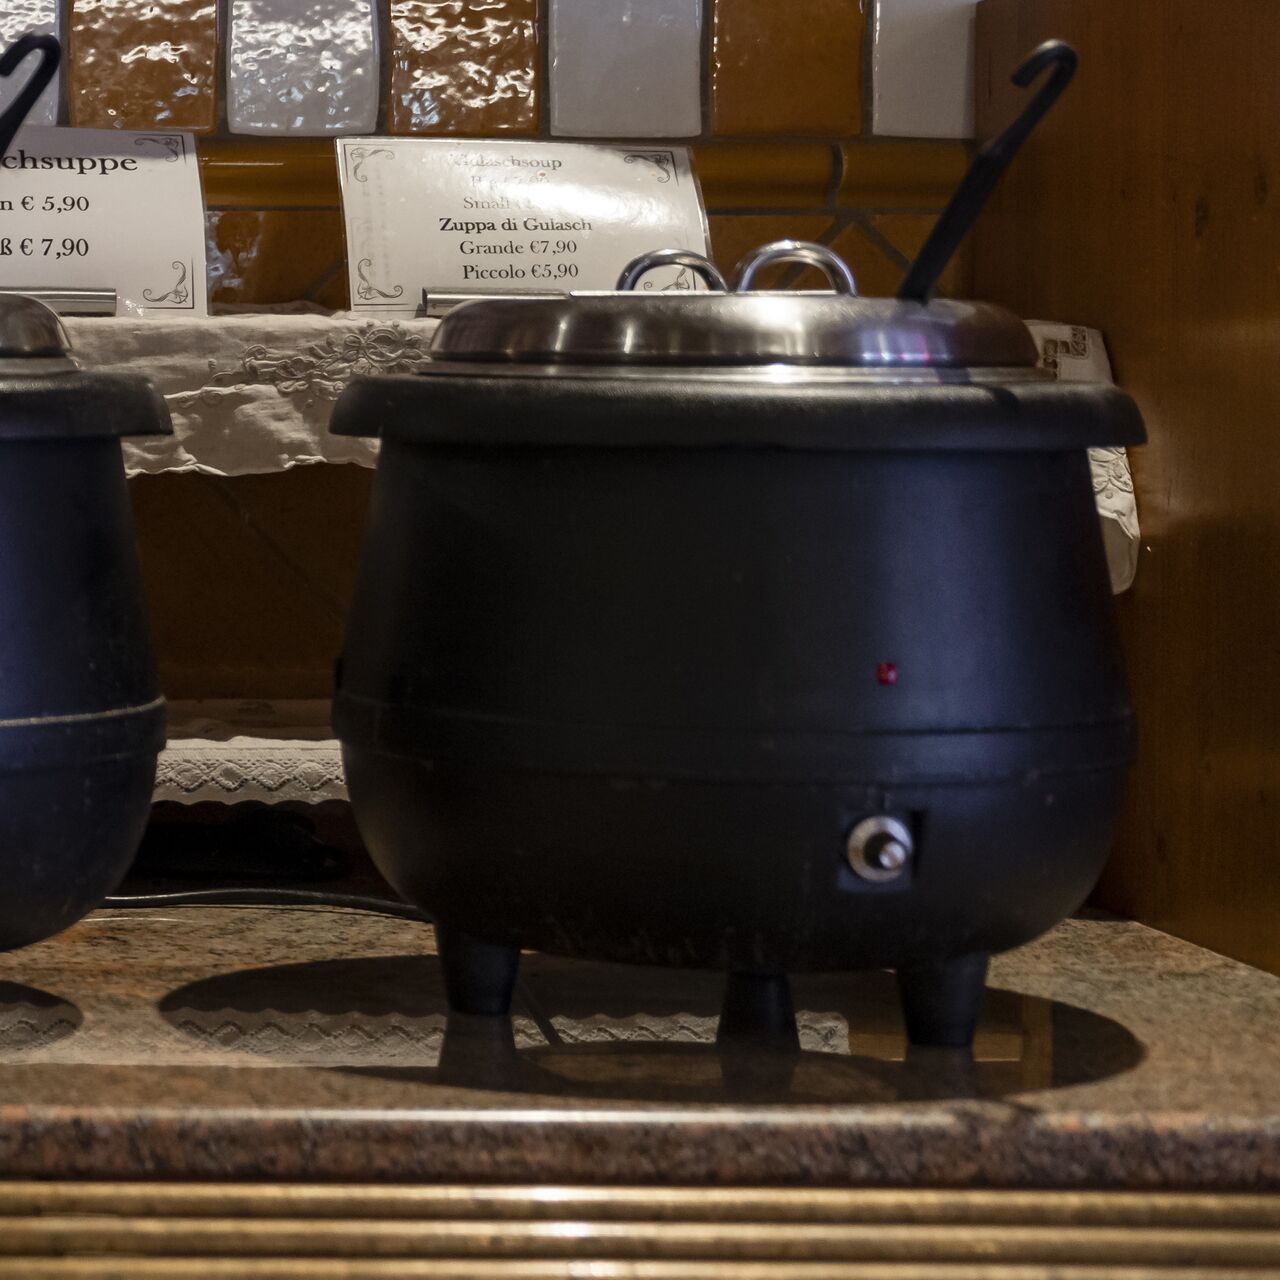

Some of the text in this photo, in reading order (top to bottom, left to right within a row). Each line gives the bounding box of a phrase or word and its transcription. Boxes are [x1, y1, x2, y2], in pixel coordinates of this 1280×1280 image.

[20, 195, 35, 211] €
[41, 195, 90, 214] 5,90
[439, 217, 593, 234] Zuppa di Gulasch
[19, 237, 34, 256] €
[41, 238, 89, 259] 7,90
[460, 240, 578, 256] Grande €7,90
[463, 263, 579, 280] Piccolo €5,90
